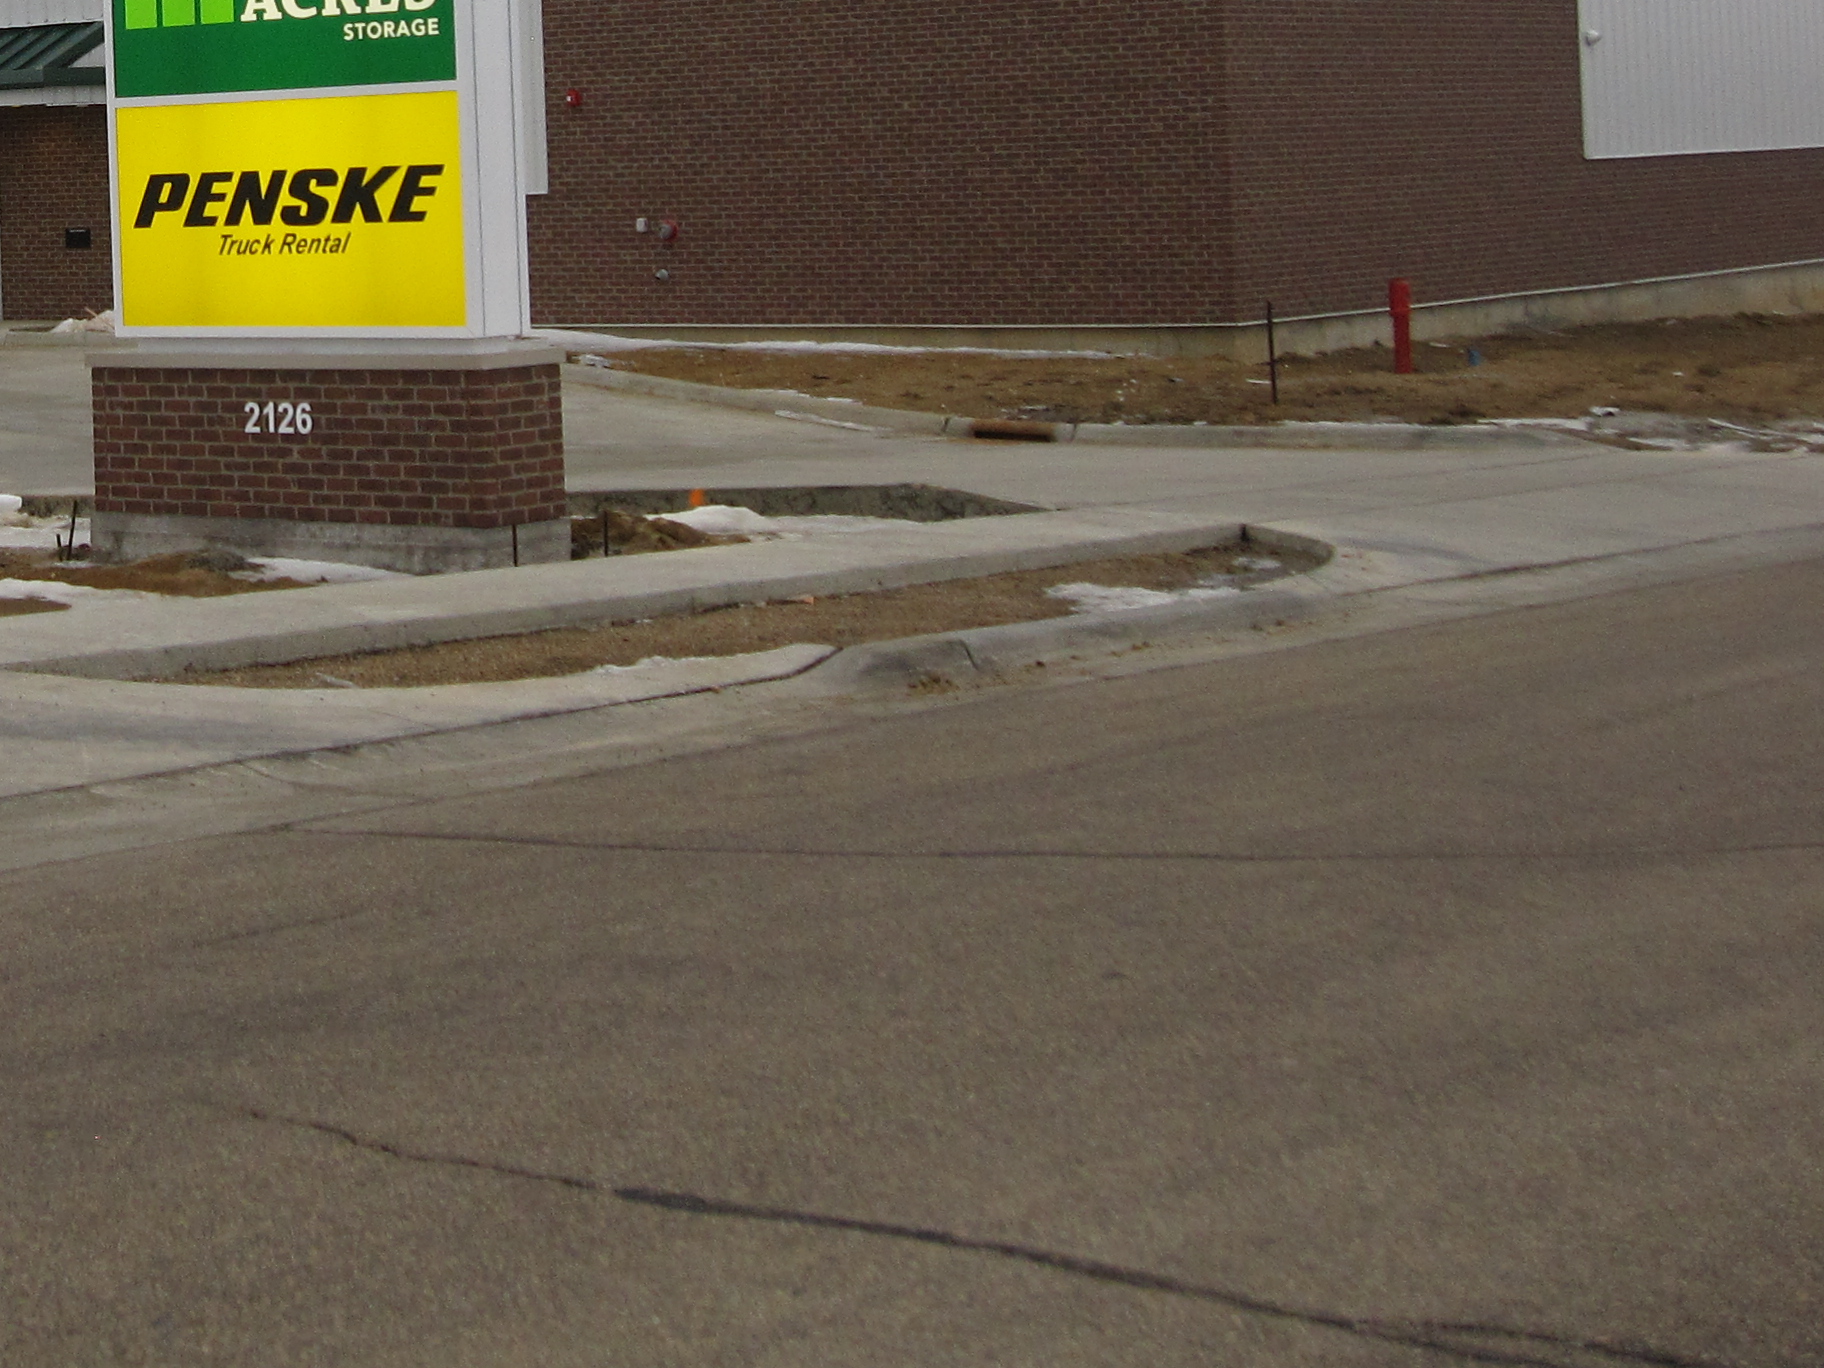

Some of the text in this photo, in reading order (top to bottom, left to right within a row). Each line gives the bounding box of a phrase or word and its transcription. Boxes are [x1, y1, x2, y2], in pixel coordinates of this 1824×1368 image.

[343, 17, 440, 41] STORAGE
[133, 164, 445, 229] PENSKE
[218, 232, 352, 256] Truck Rental
[244, 401, 313, 434] 2126
